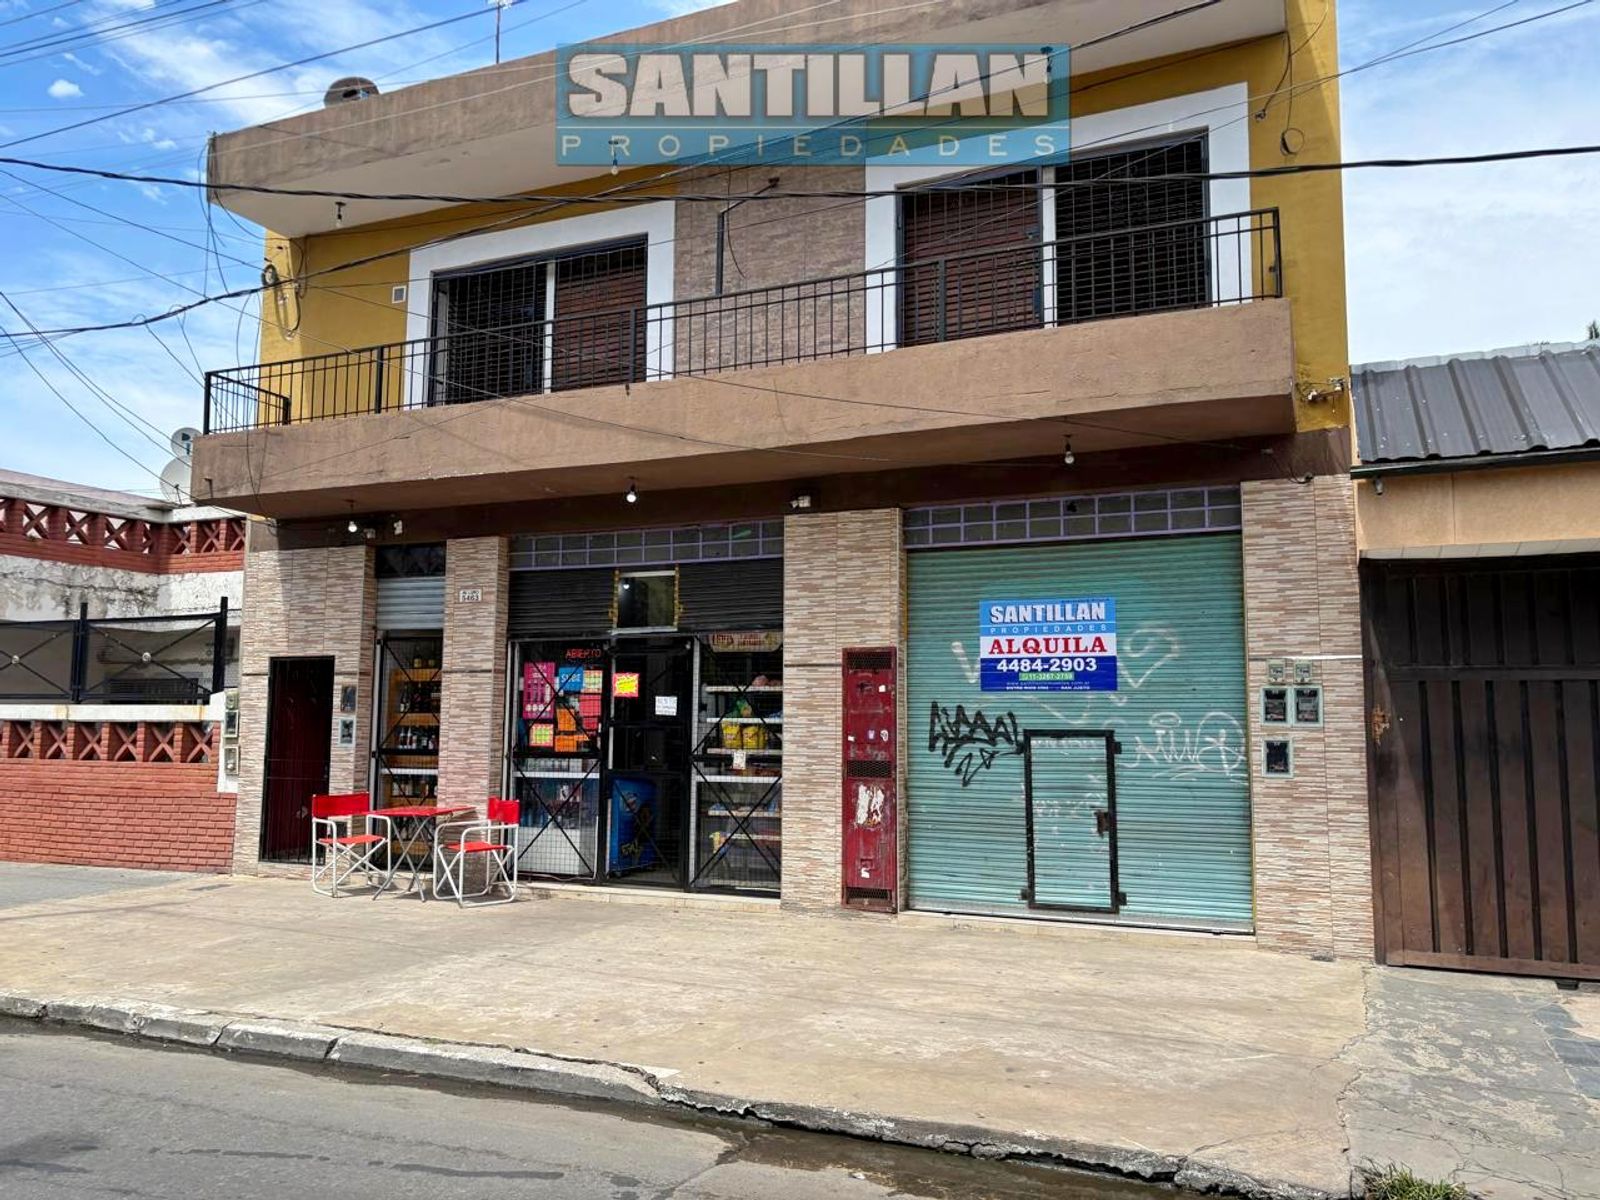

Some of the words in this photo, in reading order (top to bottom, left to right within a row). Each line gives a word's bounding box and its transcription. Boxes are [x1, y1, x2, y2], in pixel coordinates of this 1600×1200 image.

[990, 602, 1105, 624] SANTILLAN
[990, 624, 1106, 634] PROPIEDADES
[988, 636, 1107, 655] ALQUILA
[996, 658, 1097, 672] 4484-2903
